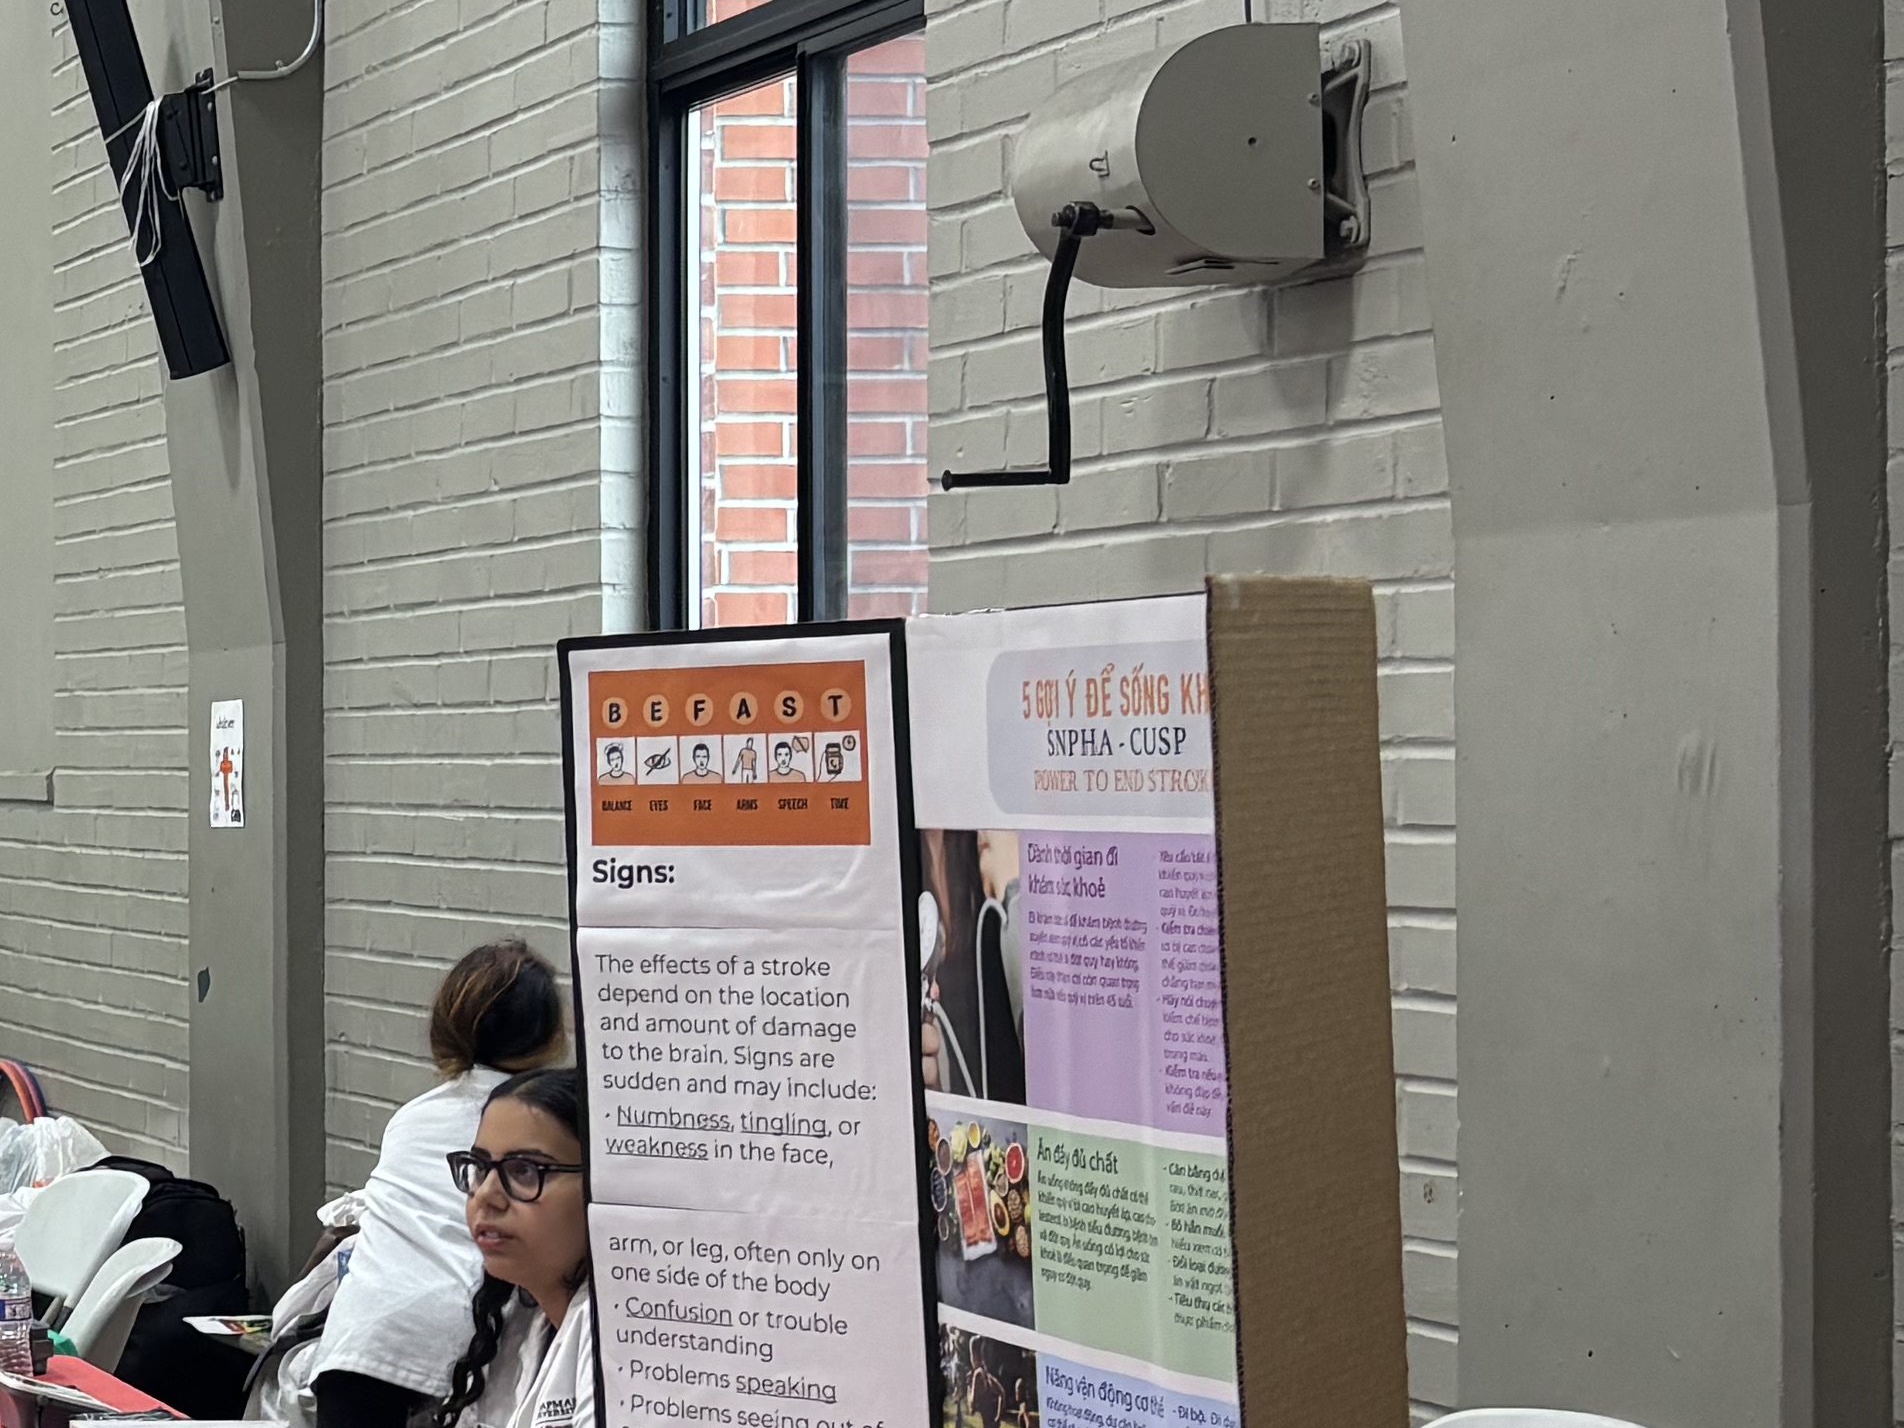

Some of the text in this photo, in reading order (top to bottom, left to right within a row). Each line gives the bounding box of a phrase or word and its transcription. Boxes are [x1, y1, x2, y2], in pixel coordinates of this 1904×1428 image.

[1023, 681, 1031, 719] 5
[1065, 670, 1076, 718] Ý
[1086, 663, 1115, 717] ĐỂ
[1120, 662, 1170, 716] SỐNG
[609, 695, 843, 723] B E F A S T
[1048, 727, 1186, 756] SNPHA CUSP
[1034, 770, 1077, 791] POWER
[1083, 769, 1108, 792] TO
[1115, 769, 1143, 792] END
[693, 799, 712, 811] FACE
[778, 798, 808, 810] SPEECH
[1074, 846, 1102, 869] gian
[593, 858, 674, 889] Signs:
[595, 953, 830, 976] The effects of a stroke
[598, 983, 849, 1008] depend on the location
[600, 1012, 856, 1042] and amount of damage
[602, 1042, 835, 1070] to the brain. Signs are
[603, 1071, 876, 1101] sudden and may include:
[617, 1105, 861, 1139] Numbness, tingling, or
[606, 1136, 833, 1169] weakness in the face,
[1089, 1150, 1118, 1174] chất
[610, 1237, 880, 1272] arm, or leg, often only on
[611, 1264, 830, 1302] one side of the body
[625, 1297, 848, 1335] Confusion or trouble
[617, 1327, 773, 1362] understanding
[630, 1359, 837, 1404] Problems speaking
[1098, 1381, 1132, 1412] động
[631, 1394, 732, 1423] Problems
